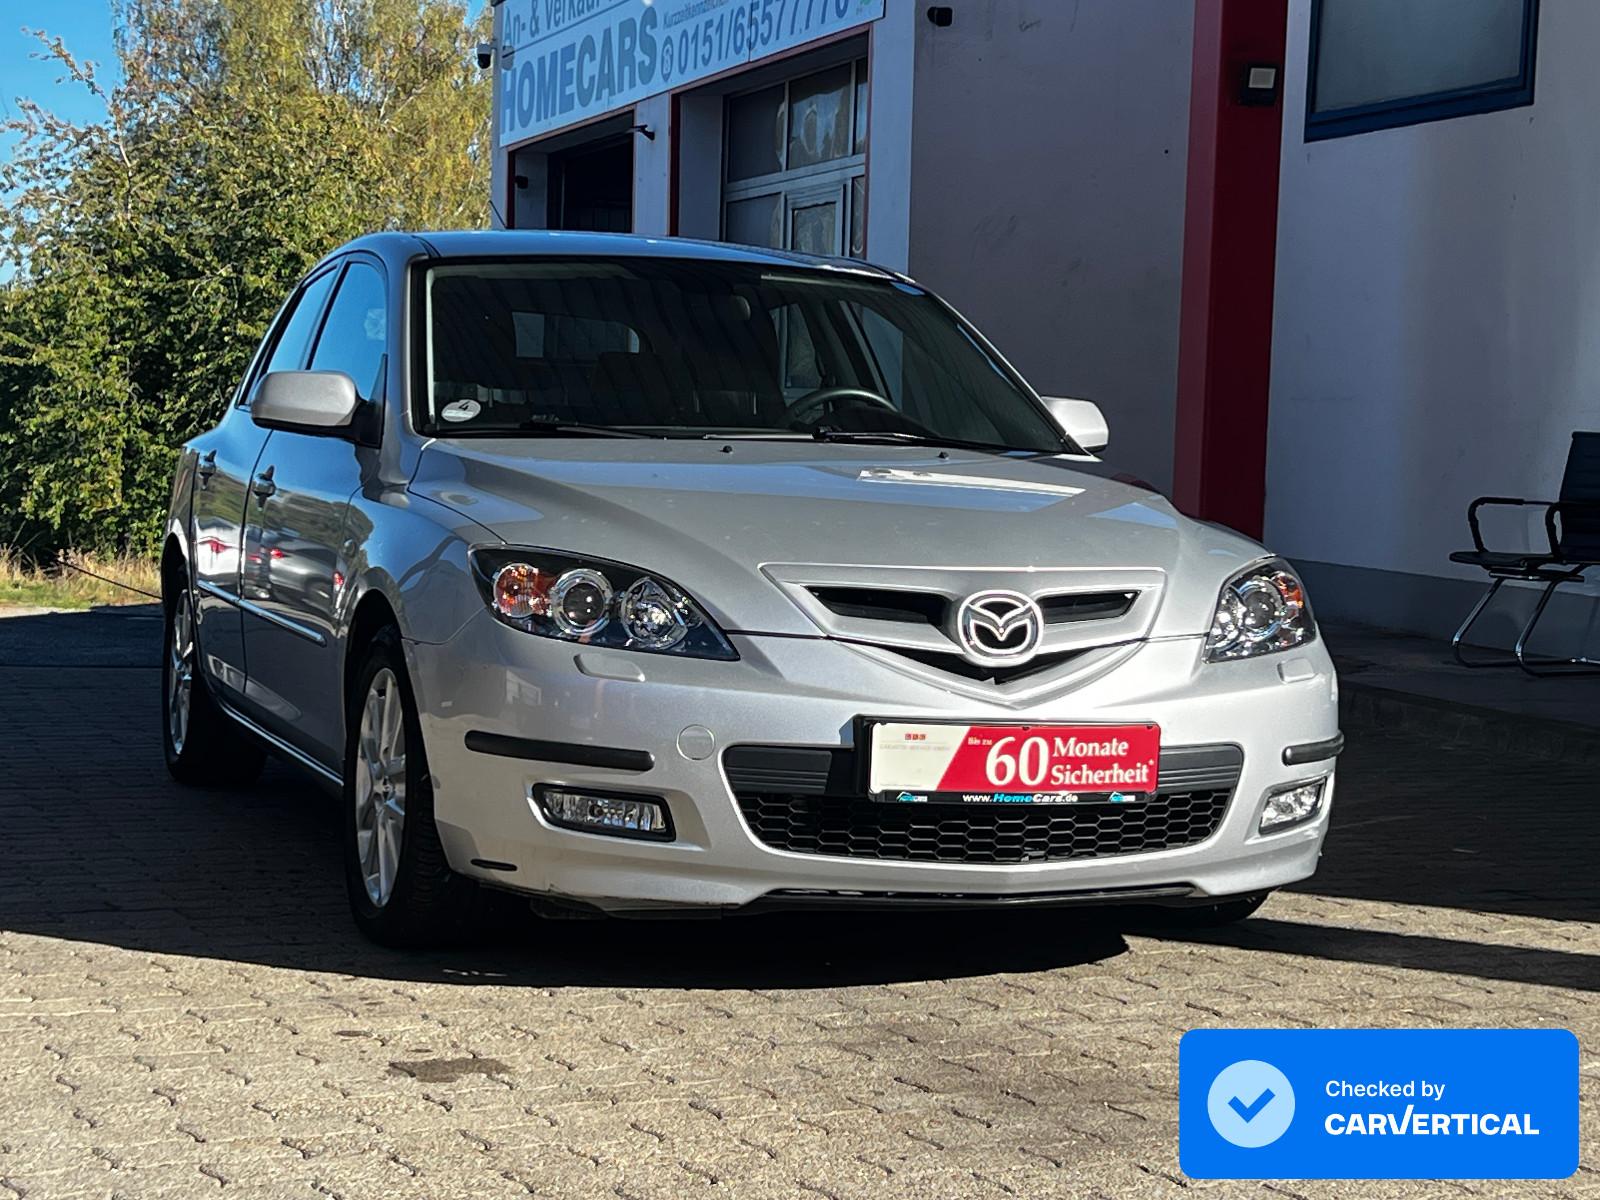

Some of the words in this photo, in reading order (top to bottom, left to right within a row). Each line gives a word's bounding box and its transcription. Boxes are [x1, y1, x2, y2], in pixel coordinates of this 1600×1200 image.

[503, 7, 527, 47] An-
[530, 0, 540, 38] &
[545, 0, 600, 31] Verka
[502, 6, 658, 135] HOMECARS
[985, 736, 1049, 786] 60
[1052, 737, 1129, 757] Monate
